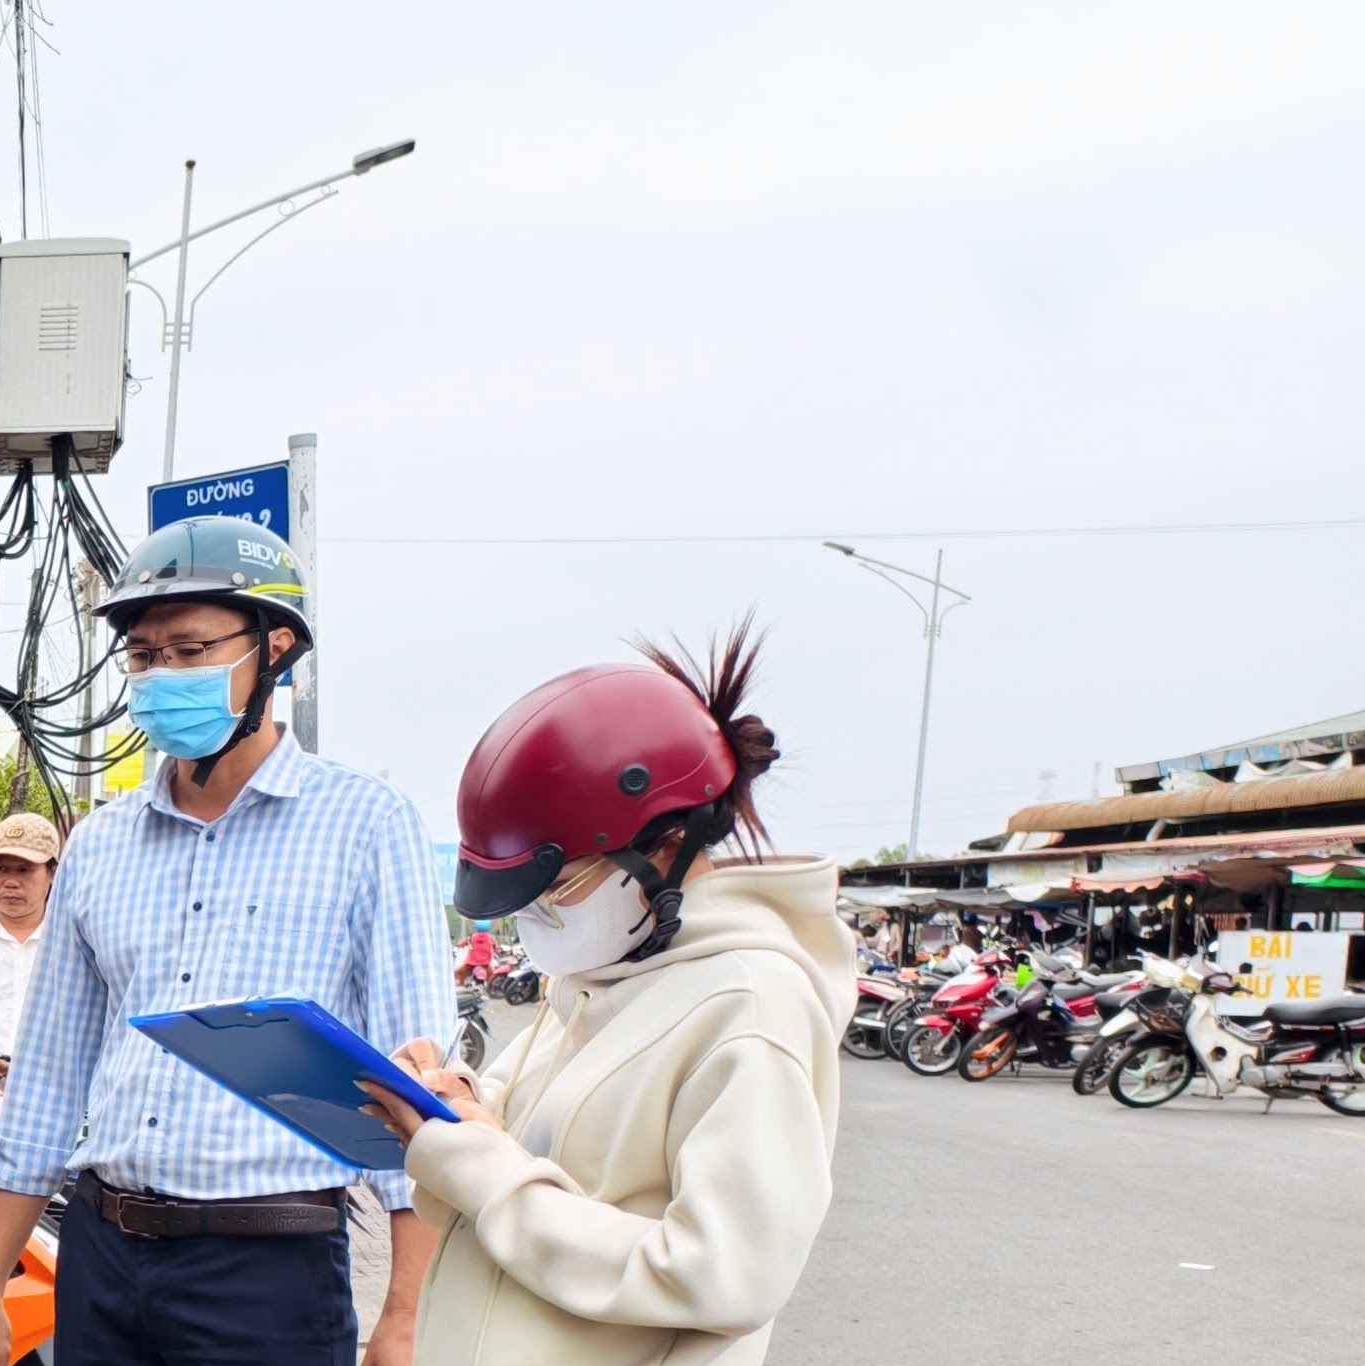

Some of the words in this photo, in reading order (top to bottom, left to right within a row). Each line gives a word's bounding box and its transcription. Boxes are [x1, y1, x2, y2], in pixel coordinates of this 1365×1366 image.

[186, 478, 254, 507] ĐƯỜNG
[238, 538, 282, 566] BIDV
[1286, 975, 1322, 999] XE
